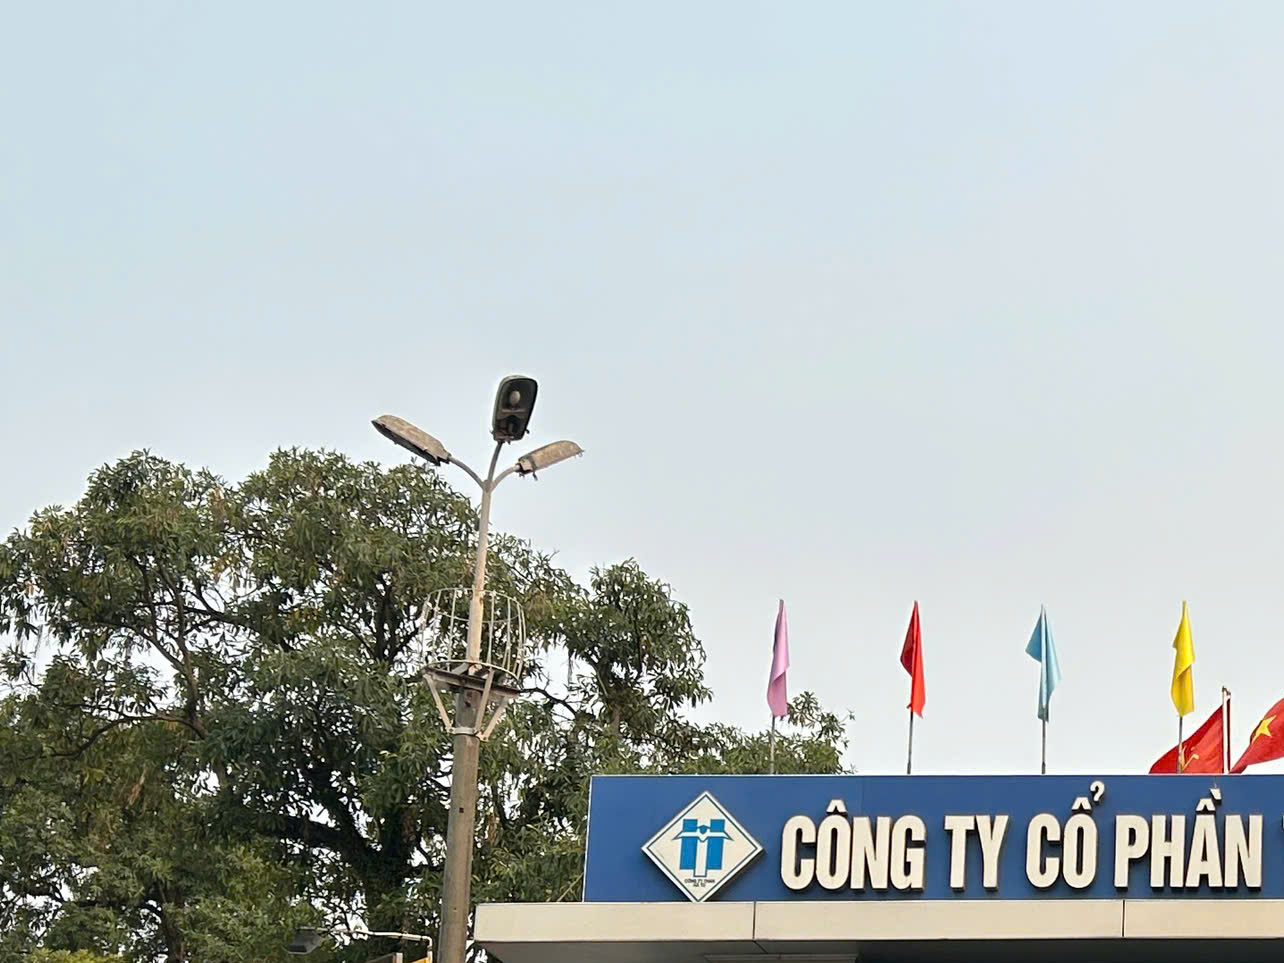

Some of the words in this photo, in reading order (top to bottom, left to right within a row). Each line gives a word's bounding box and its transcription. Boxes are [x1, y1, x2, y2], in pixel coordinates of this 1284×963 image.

[781, 799, 926, 891] CÔNG
[944, 814, 1009, 889] TY
[1025, 781, 1105, 889] CỔ
[1114, 788, 1263, 888] PHẦN
